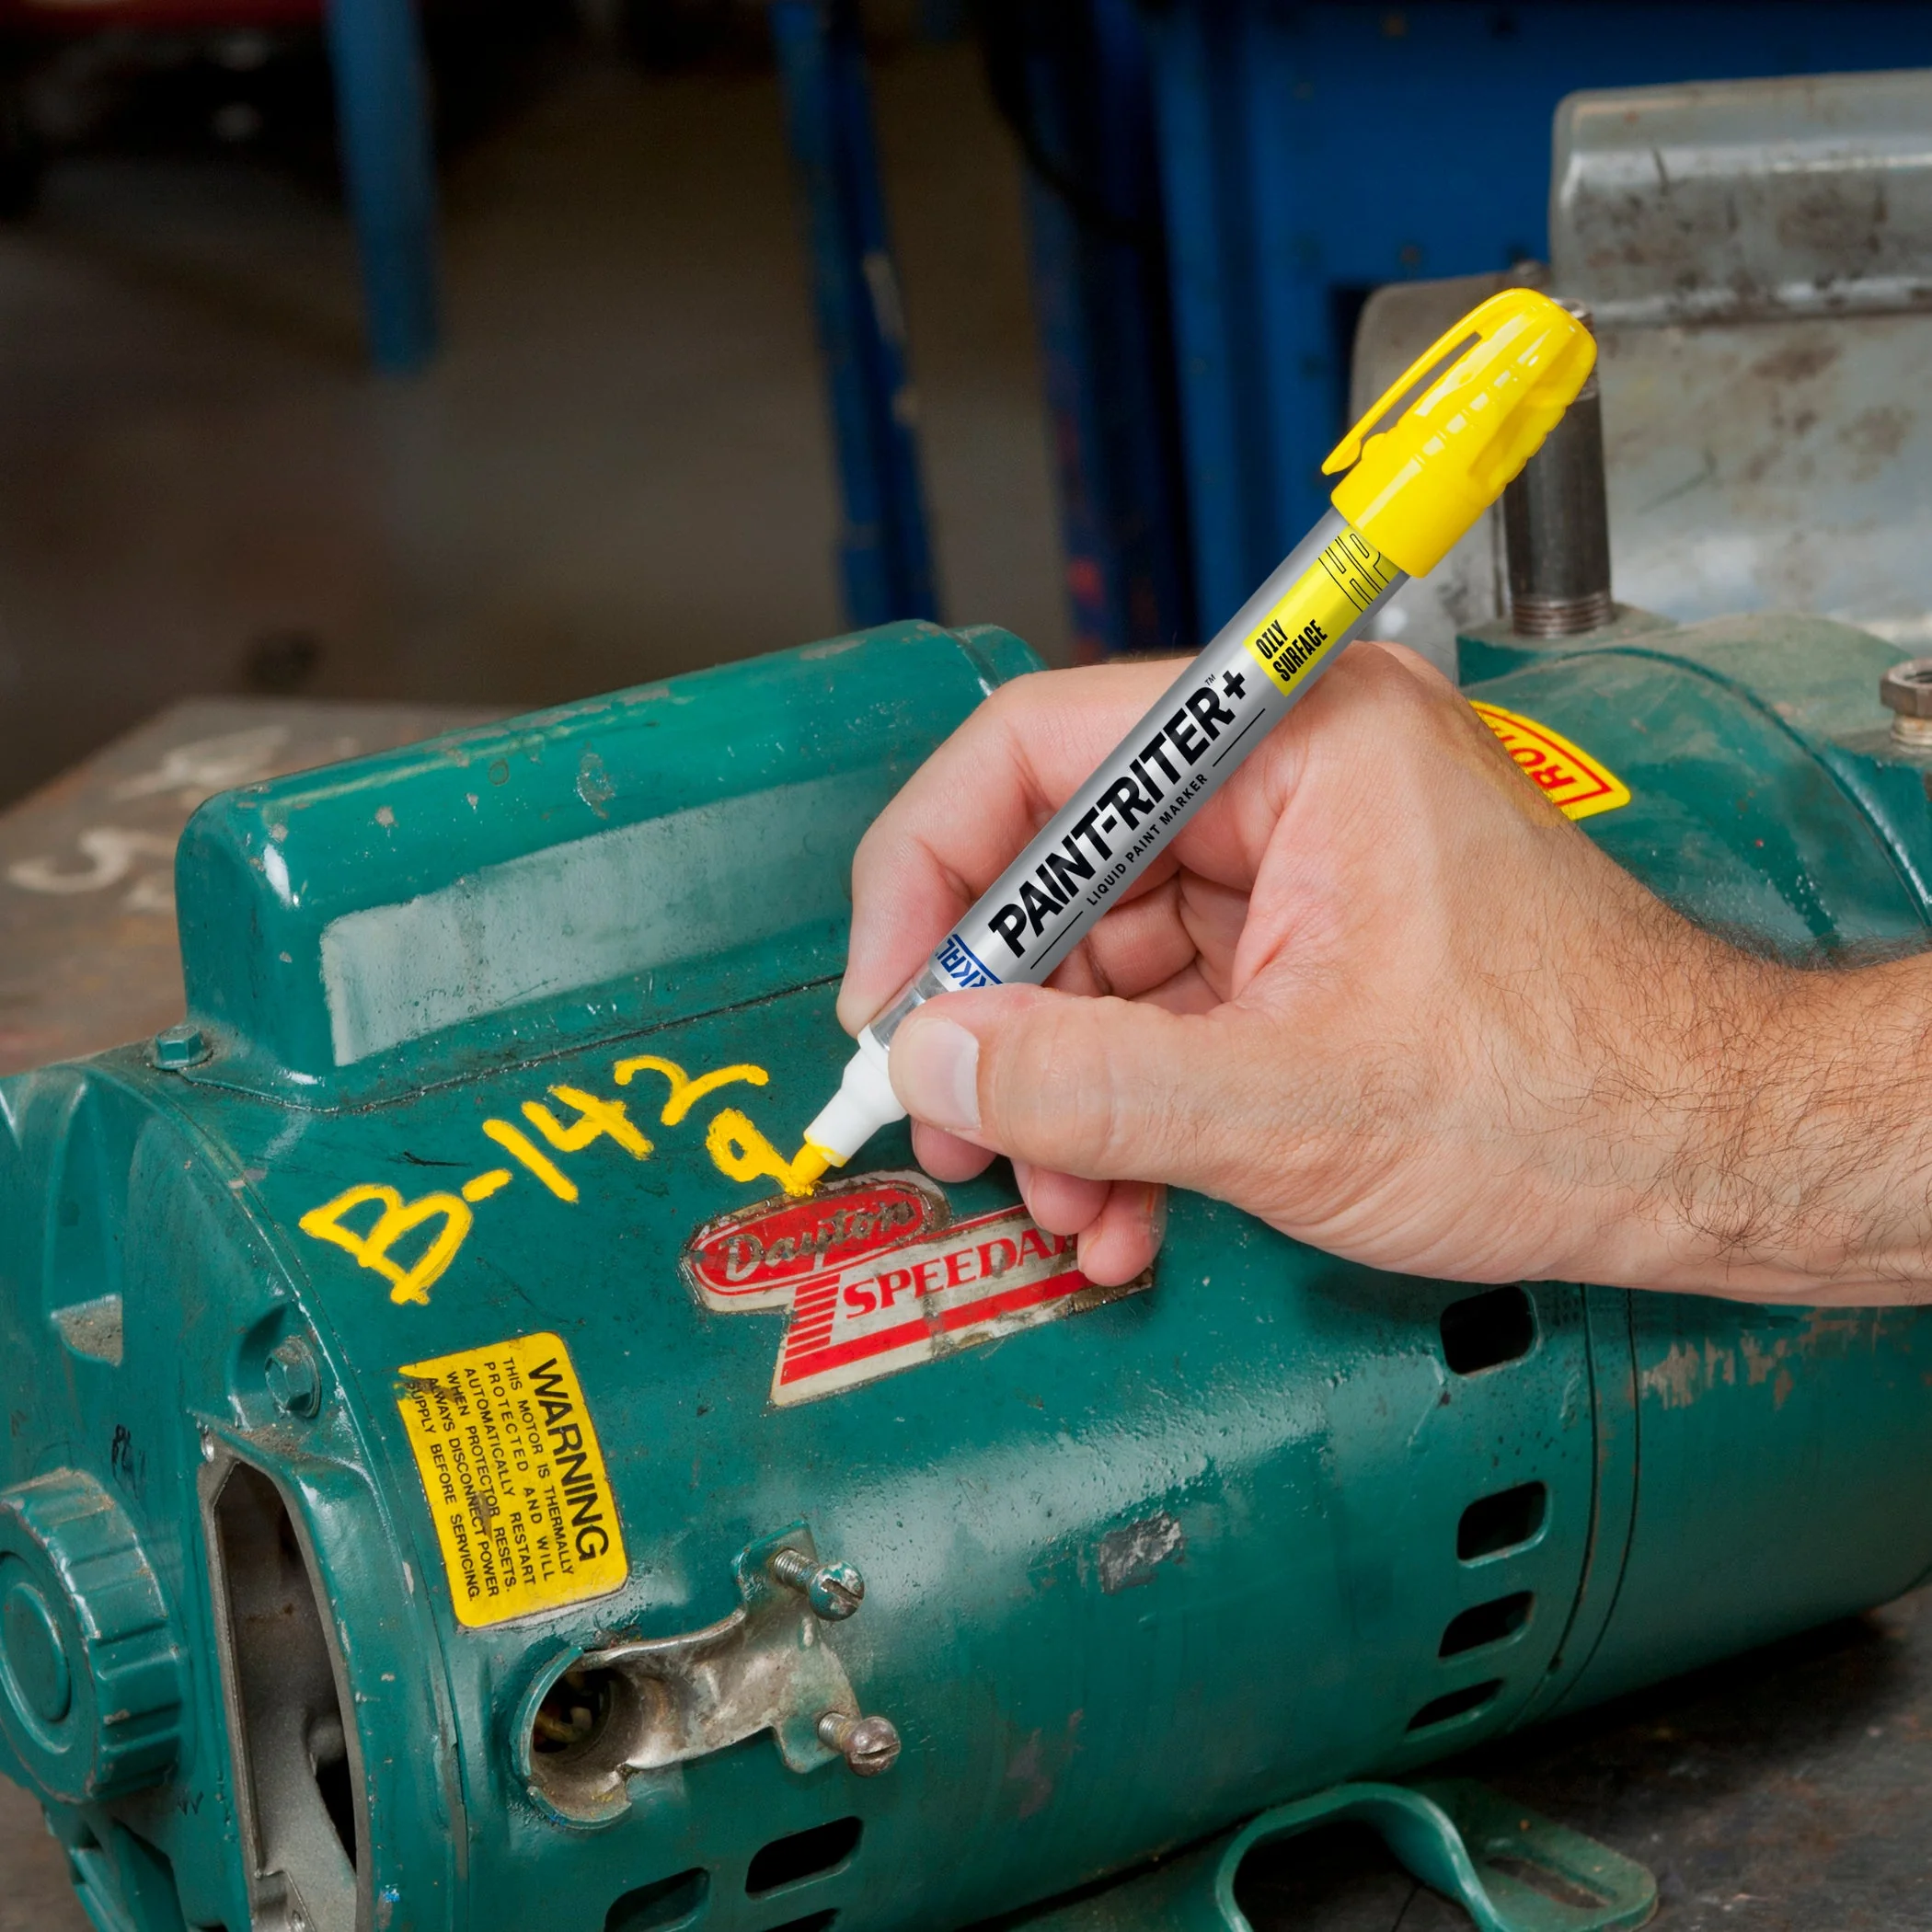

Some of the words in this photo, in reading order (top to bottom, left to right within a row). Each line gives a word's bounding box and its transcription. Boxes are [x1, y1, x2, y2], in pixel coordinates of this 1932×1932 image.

[1255, 619, 1288, 660] OILY
[1272, 619, 1328, 682] SURFACE
[1086, 862, 1127, 906] LIQUID
[1124, 824, 1161, 863] PAINT
[1162, 773, 1208, 825] MARKER
[718, 1201, 917, 1282] Dayton
[428, 1377, 455, 1432] ALWAYS
[449, 1437, 487, 1536] DISCONNECT
[477, 1541, 500, 1597] POWER
[430, 1443, 457, 1506] BEFORE
[450, 1513, 480, 1602] SERVICING.
[446, 1371, 471, 1417] WHEN
[465, 1425, 500, 1518] PROTECTOR
[493, 1526, 517, 1593] RESETS.
[464, 1368, 517, 1497] AUTOMATICALLY
[510, 1512, 536, 1585] RESTART
[484, 1362, 529, 1472] PROTECTED
[523, 1487, 543, 1524] AND
[536, 1535, 555, 1581] WILL
[502, 1356, 523, 1391] THIS
[517, 1399, 545, 1455] MOTOR
[537, 1464, 551, 1479] IS
[544, 1485, 574, 1575] THERMALLY
[527, 1357, 610, 1562] WARNING
